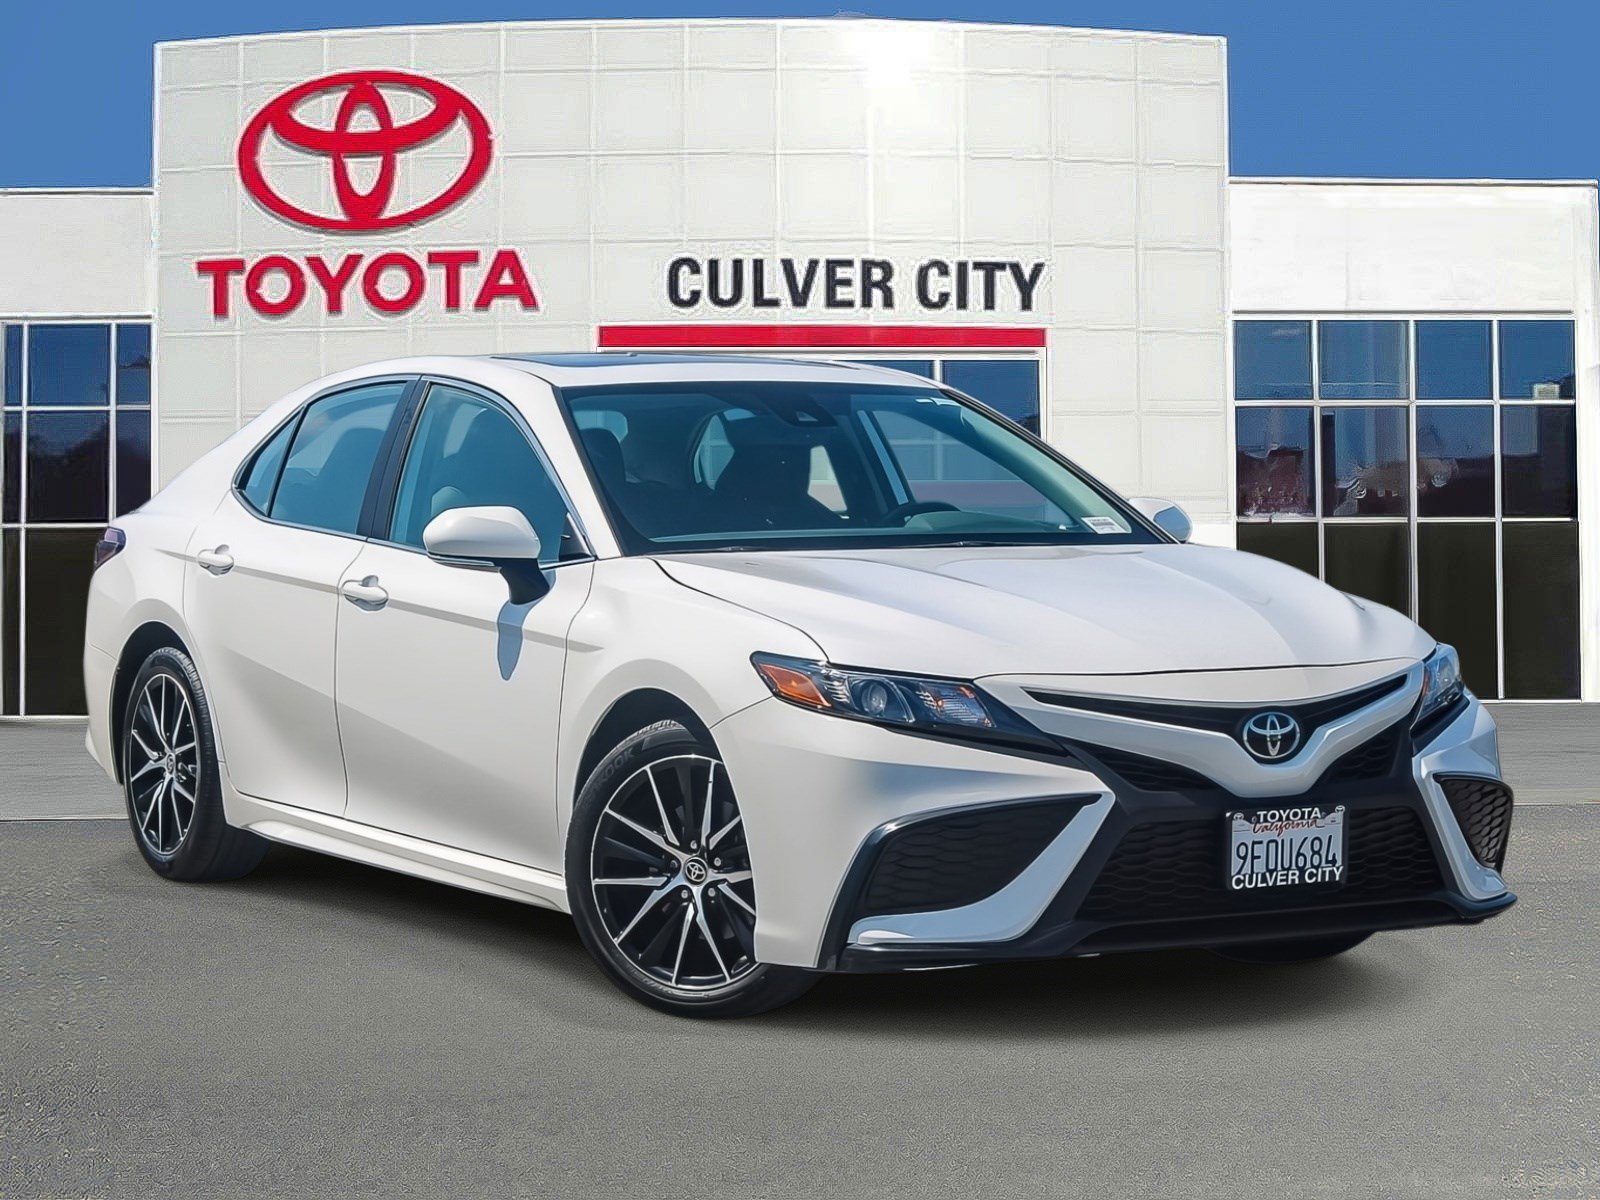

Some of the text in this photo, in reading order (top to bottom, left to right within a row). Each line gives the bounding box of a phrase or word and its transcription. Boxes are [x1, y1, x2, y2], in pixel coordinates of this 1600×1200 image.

[196, 248, 539, 318] TOYOTA
[668, 257, 1046, 312] CULVER CITY
[1256, 807, 1322, 823] TOYOTA
[1252, 818, 1326, 838] California
[1231, 865, 1344, 890] CULVER CITY
